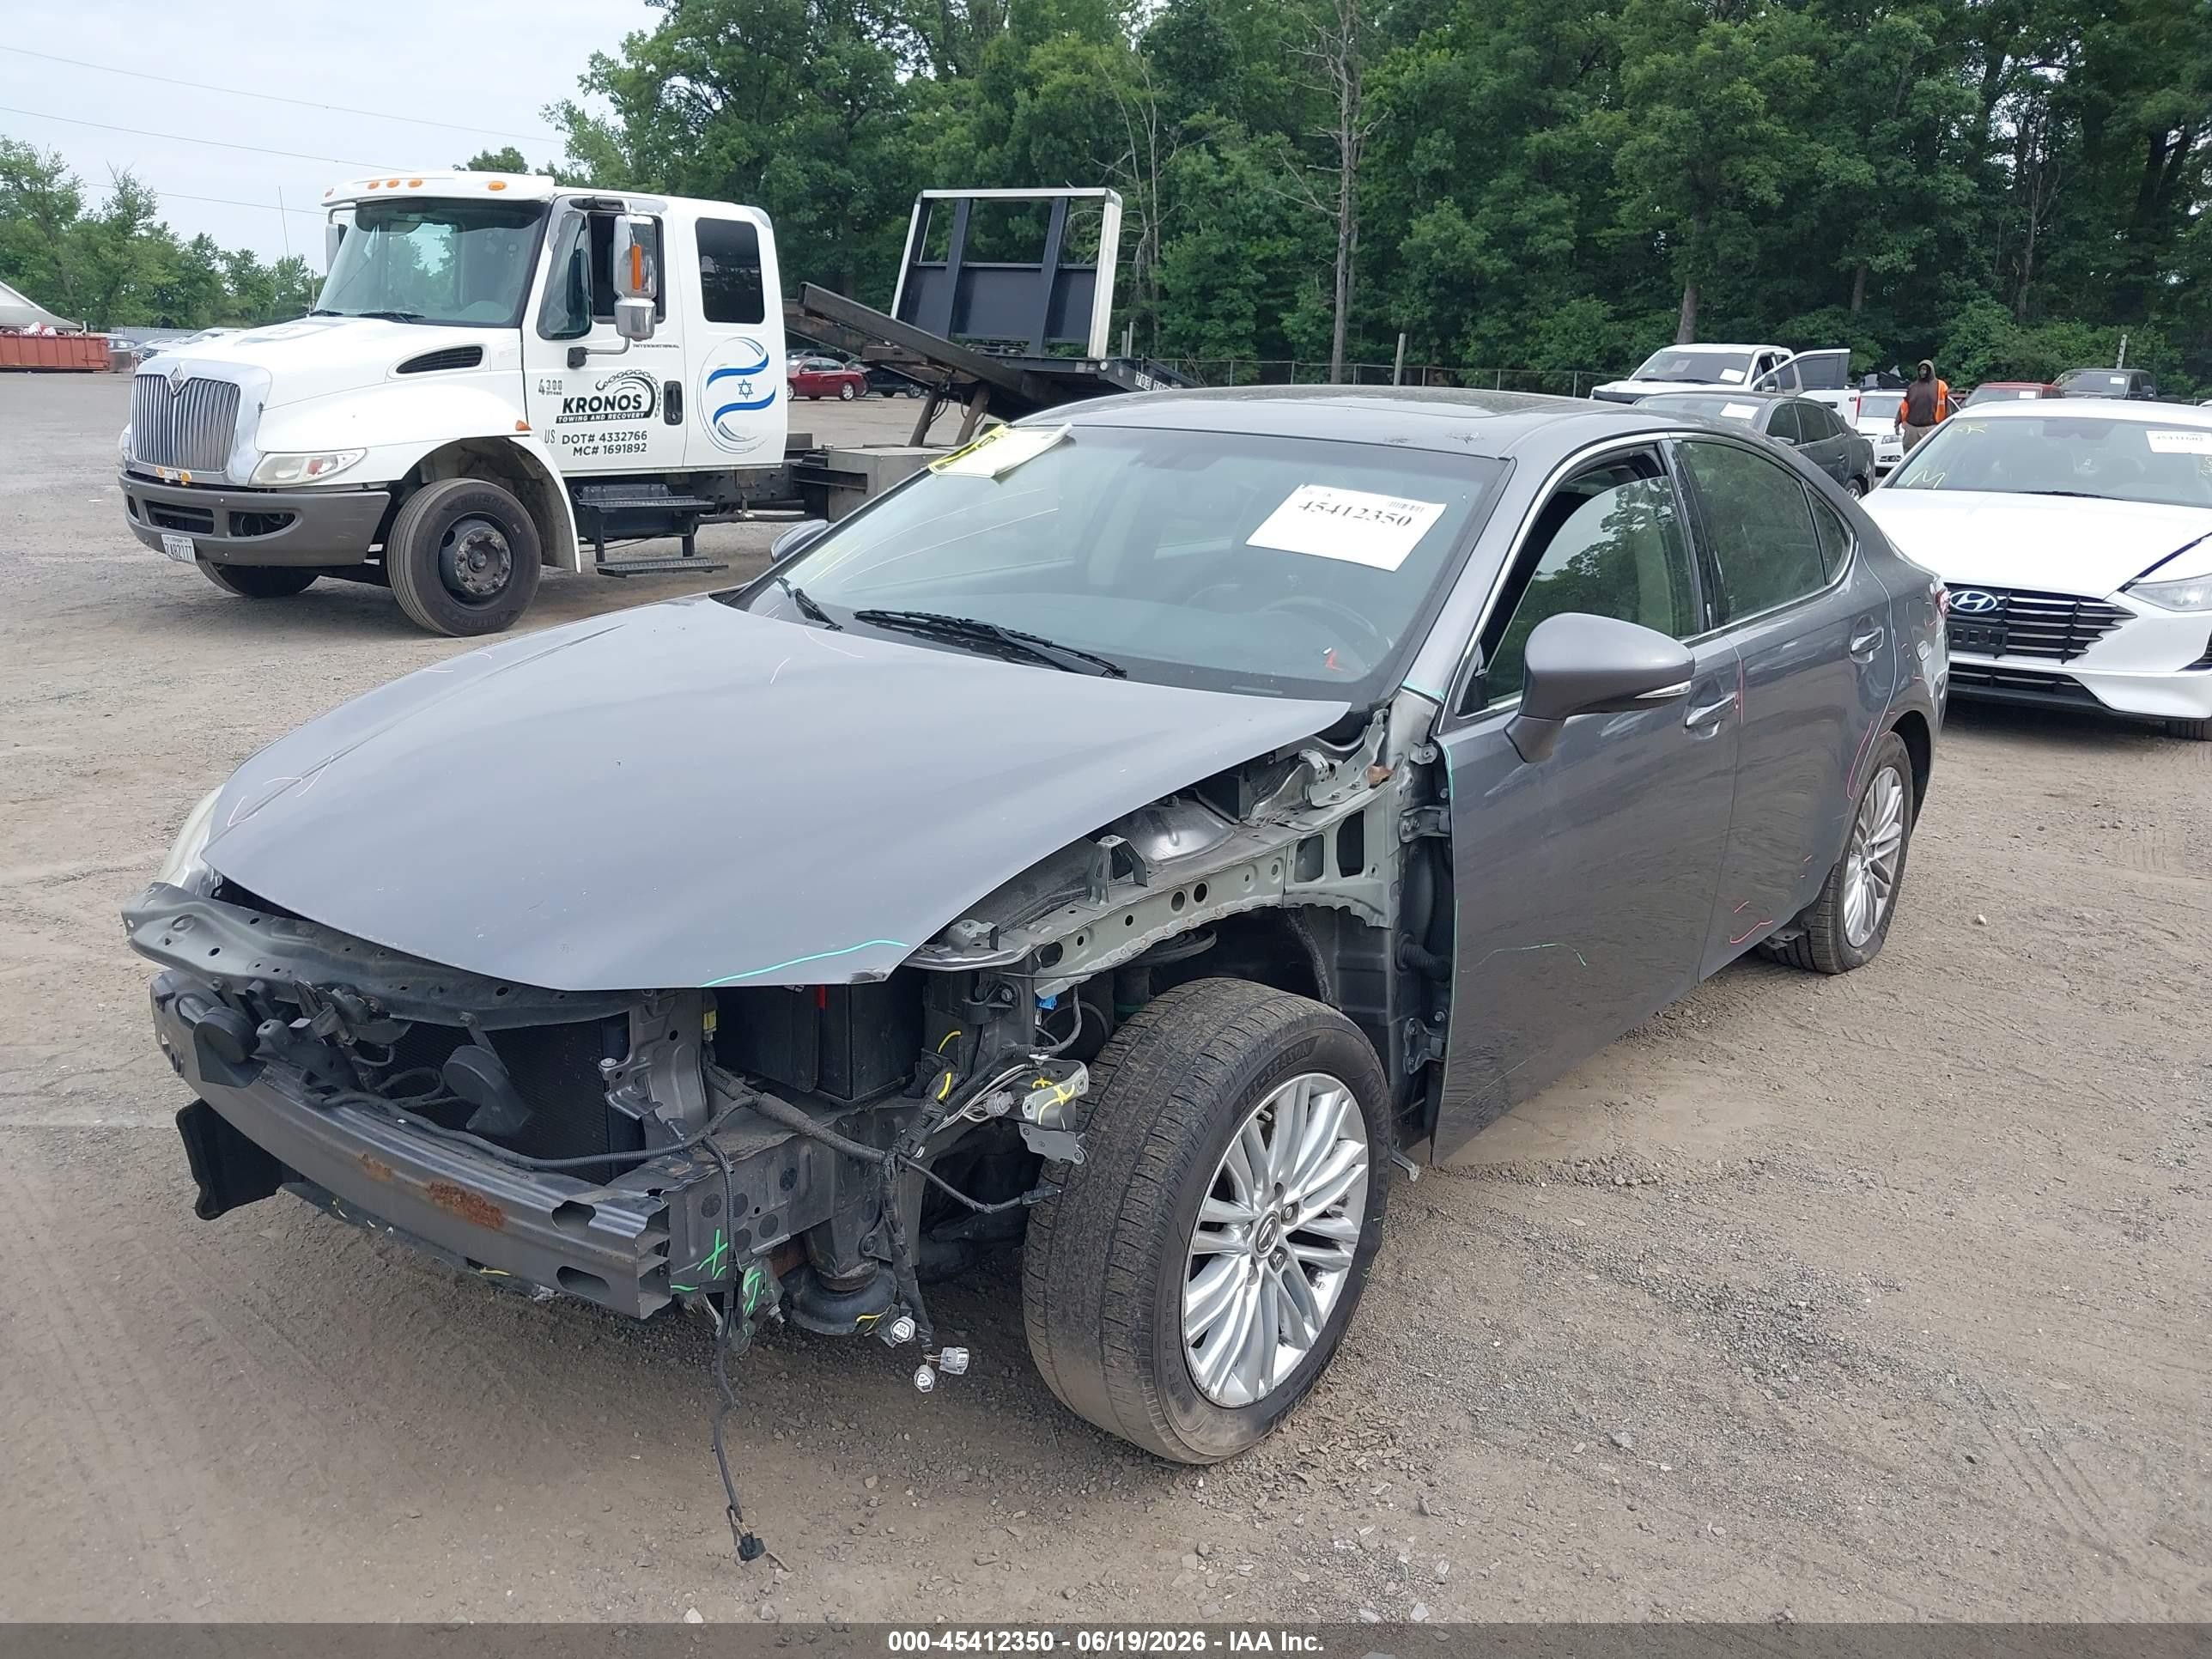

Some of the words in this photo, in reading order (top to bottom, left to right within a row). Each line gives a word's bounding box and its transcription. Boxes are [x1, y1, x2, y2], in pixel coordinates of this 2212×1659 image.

[562, 393, 642, 414] KRONOS
[558, 414, 588, 423] TOWING
[590, 413, 605, 422] AND
[607, 411, 645, 420] RECOVERY
[544, 428, 556, 444] US
[562, 433, 595, 445] DOT#
[599, 430, 647, 443] 4332766
[573, 445, 599, 457] MC#
[603, 443, 647, 455] 1691892
[1298, 501, 1413, 526] 45412350
